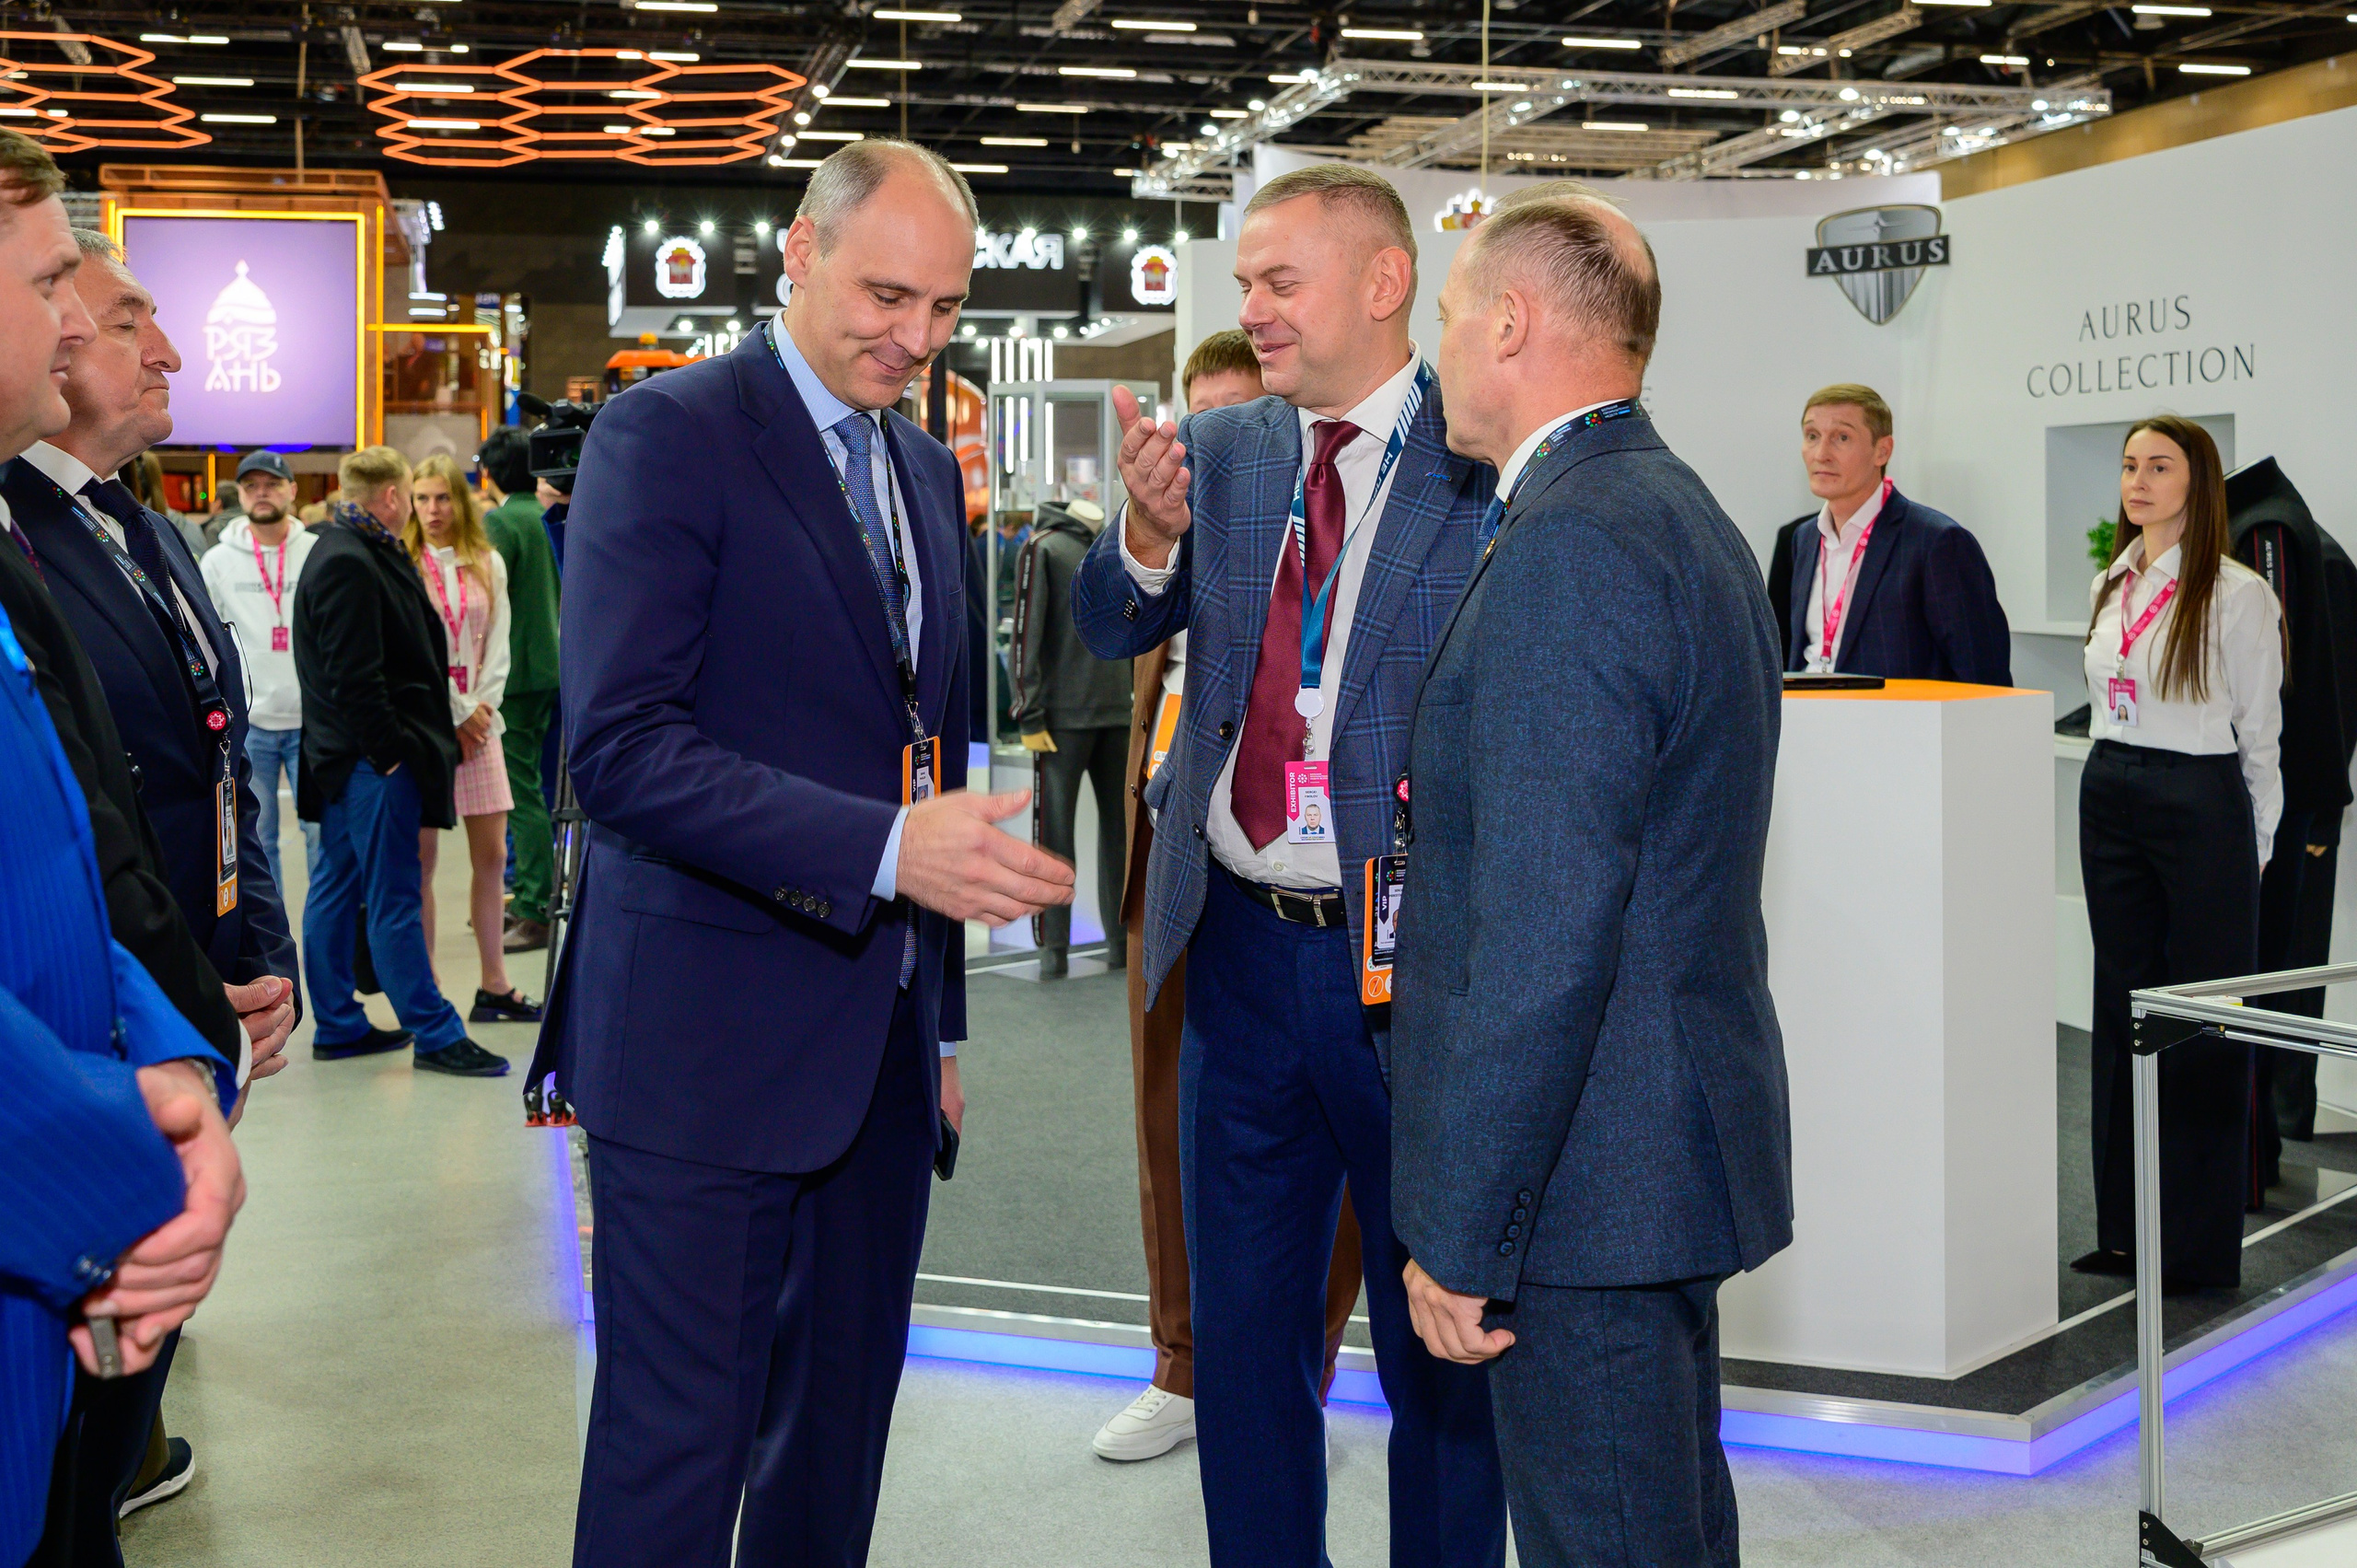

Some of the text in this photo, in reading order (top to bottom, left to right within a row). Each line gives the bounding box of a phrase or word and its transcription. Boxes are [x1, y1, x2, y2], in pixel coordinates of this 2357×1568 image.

[972, 232, 1064, 270] СКАЯ
[1813, 238, 1945, 273] AURUS
[2079, 295, 2190, 342] AURUS
[2026, 343, 2254, 398] COLLECTION
